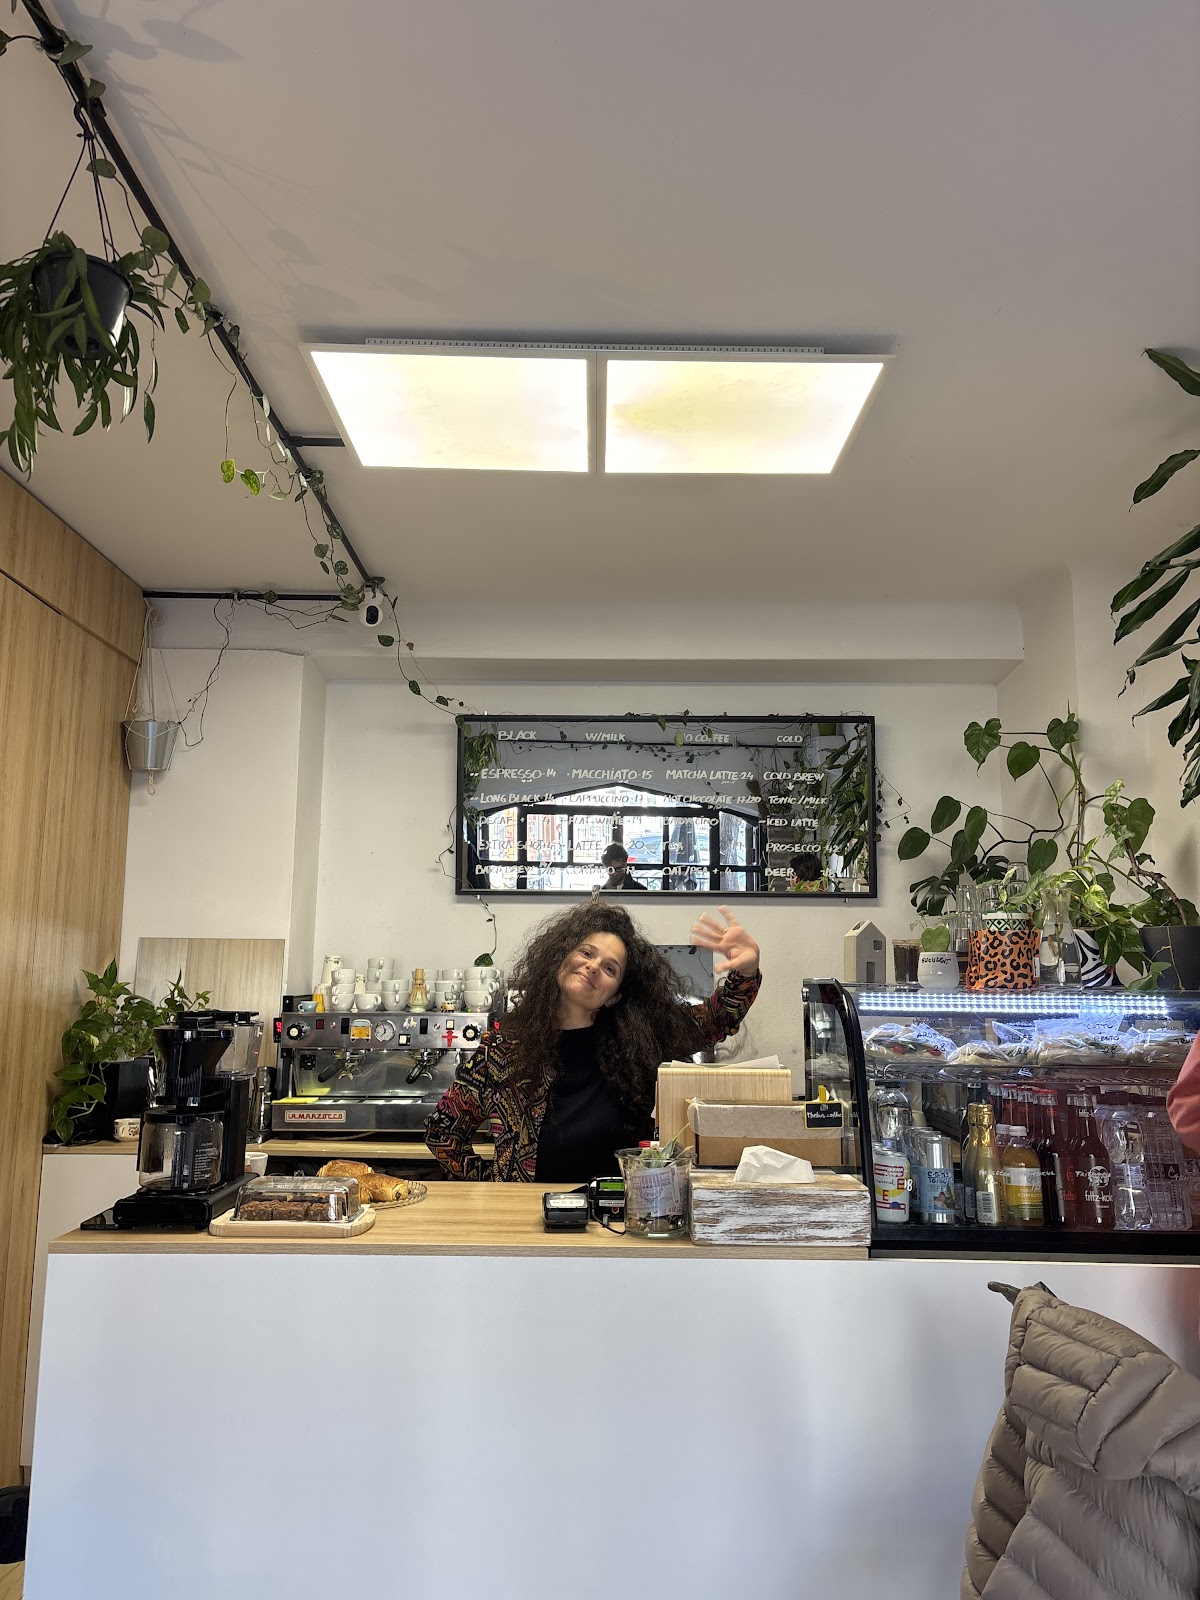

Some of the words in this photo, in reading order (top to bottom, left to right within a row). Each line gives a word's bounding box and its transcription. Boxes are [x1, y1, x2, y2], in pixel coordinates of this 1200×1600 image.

[497, 730, 537, 741] BLACK
[584, 731, 626, 742] W/MILK
[776, 734, 804, 743] COLD
[665, 769, 707, 780] MATCHA
[763, 771, 792, 781] COLD
[793, 772, 825, 782] BREW
[479, 792, 507, 804] LONG
[683, 794, 732, 804] CHOCOLATE
[568, 815, 589, 825] FLAT
[766, 814, 789, 827] ICED
[790, 817, 819, 828] LATTE
[479, 839, 513, 851] EXTRA
[567, 839, 603, 852] LATTE
[765, 842, 822, 853] PROSECCO
[764, 866, 795, 877] BEER
